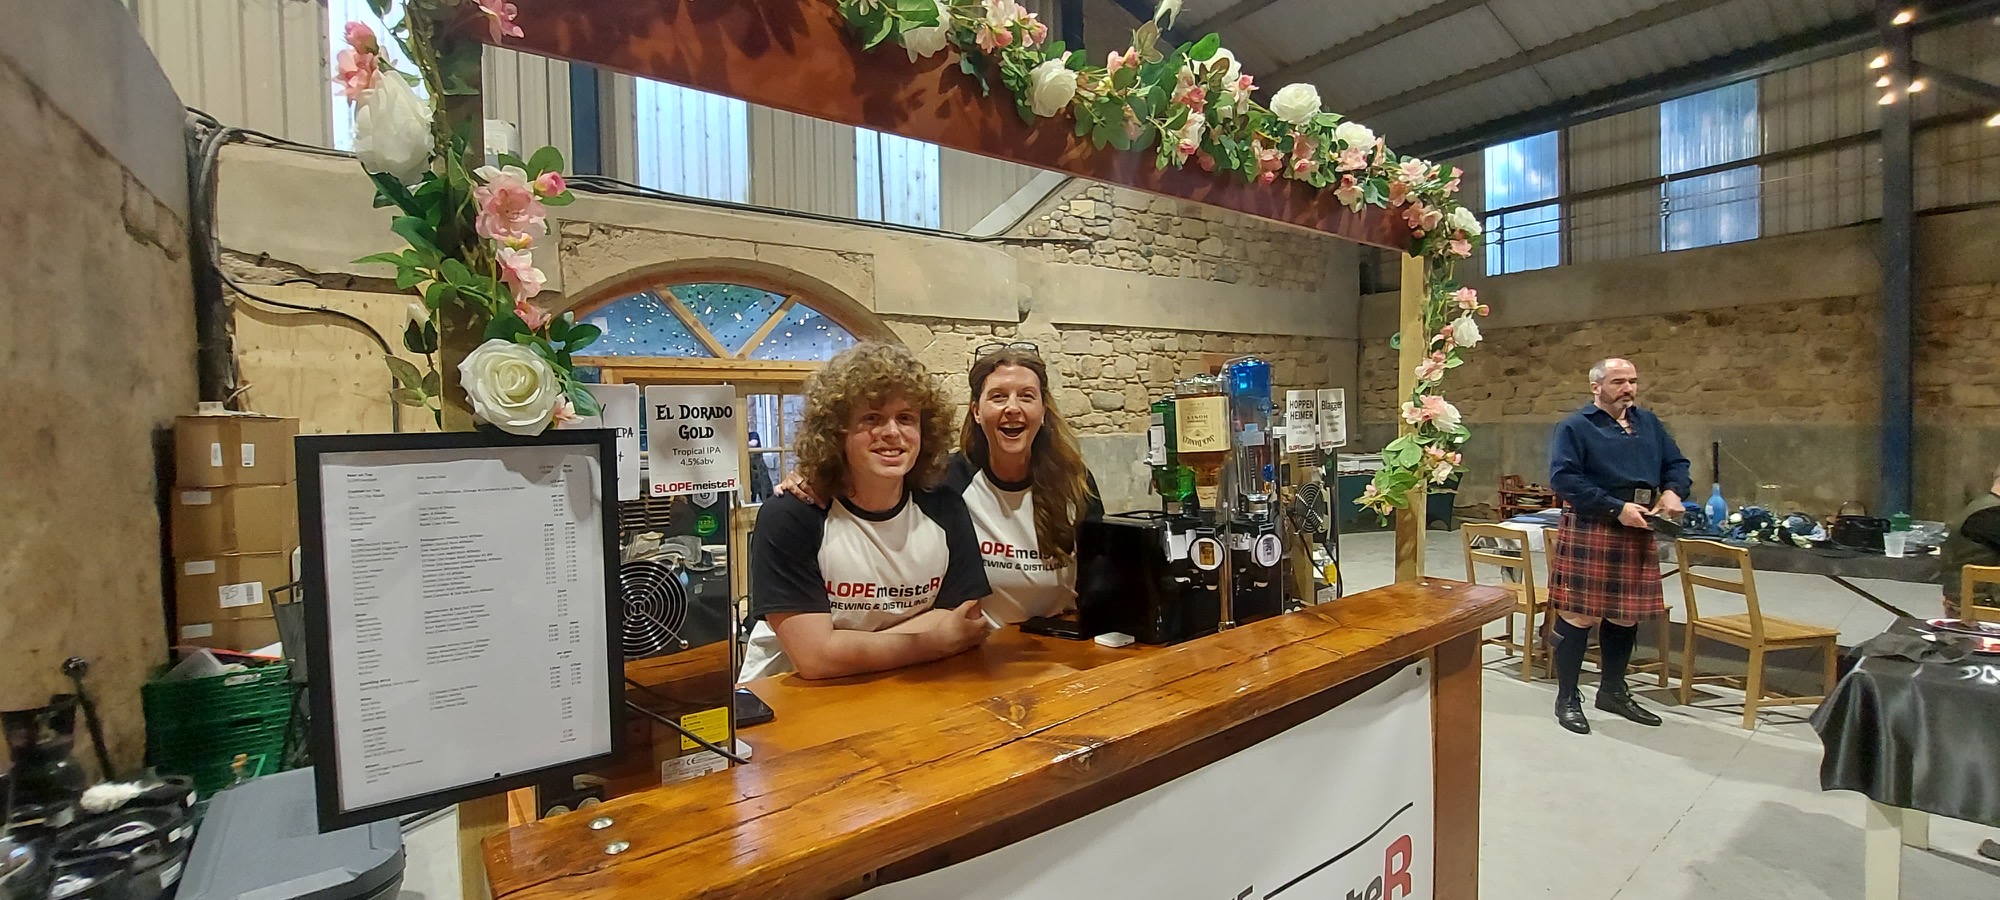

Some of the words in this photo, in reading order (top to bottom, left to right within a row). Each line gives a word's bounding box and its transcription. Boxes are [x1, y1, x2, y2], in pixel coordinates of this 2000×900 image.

[1289, 400, 1315, 410] HOPPEN
[1321, 400, 1343, 412] Blagger
[678, 404, 733, 422] DORADO
[1289, 411, 1314, 420] HEIMER
[678, 424, 714, 441] GOLD
[672, 447, 705, 457] Tropical
[706, 446, 722, 455] IPA
[680, 457, 715, 467] 4.5%abv
[654, 477, 736, 494] SLOPEmeisteR
[825, 576, 941, 598] LOPEmeisteR
[882, 597, 928, 611] DISTILLING
